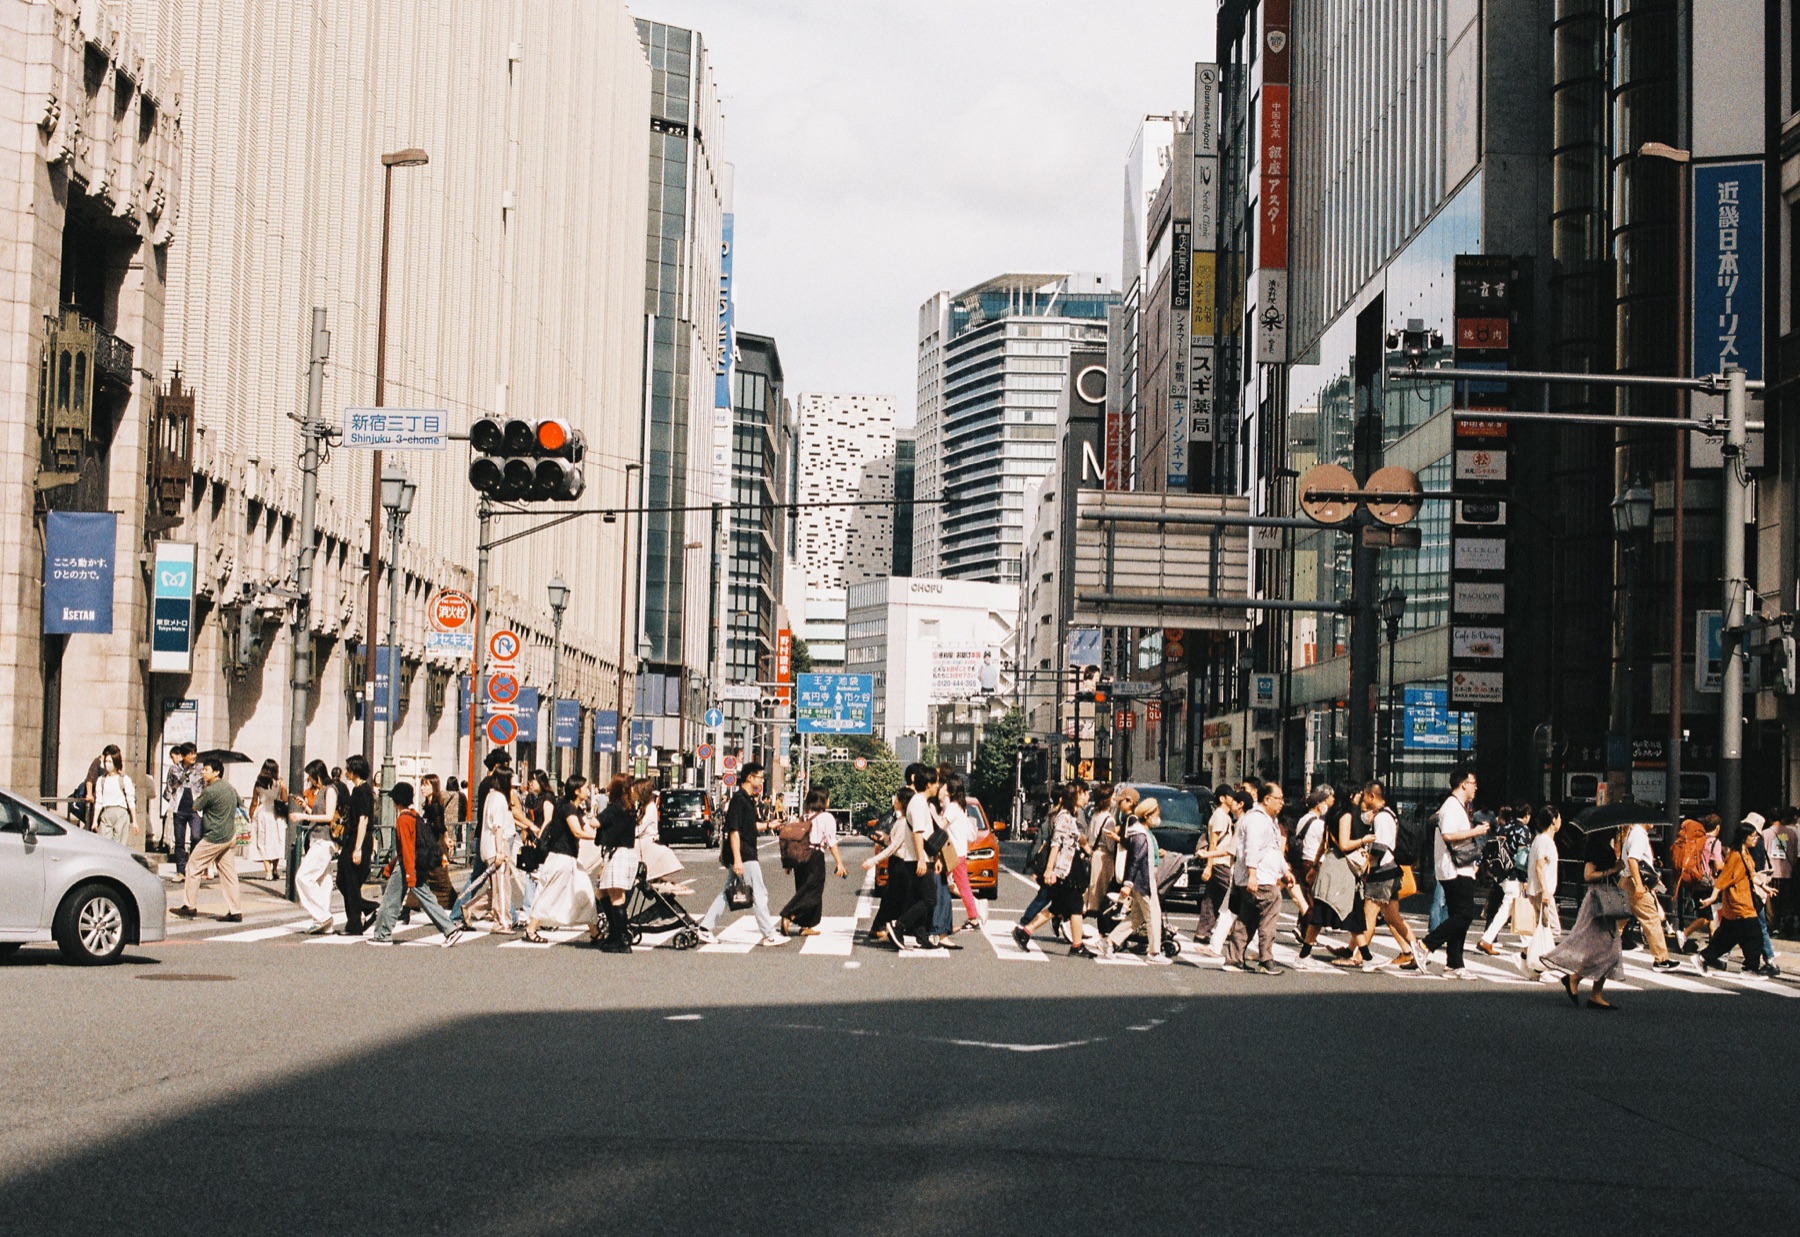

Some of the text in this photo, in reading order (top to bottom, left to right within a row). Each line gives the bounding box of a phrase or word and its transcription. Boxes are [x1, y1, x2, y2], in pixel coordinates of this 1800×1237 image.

[1202, 212, 1211, 238] Clinic
[1175, 234, 1189, 296] esquire club
[1192, 356, 1212, 434] スギ薬局
[351, 413, 439, 432] 新宿三丁目
[351, 433, 440, 445] Shinjuku 3-chome
[1171, 400, 1185, 472] キノシネマ
[54, 558, 108, 568] こころ動かす、
[53, 570, 100, 580] ひとの力で。
[911, 583, 943, 594] CHOFU
[62, 607, 95, 621] ISETAN
[438, 605, 467, 619] 消火栓
[814, 676, 859, 686] 王子 池袋
[801, 692, 830, 701] 高円寺
